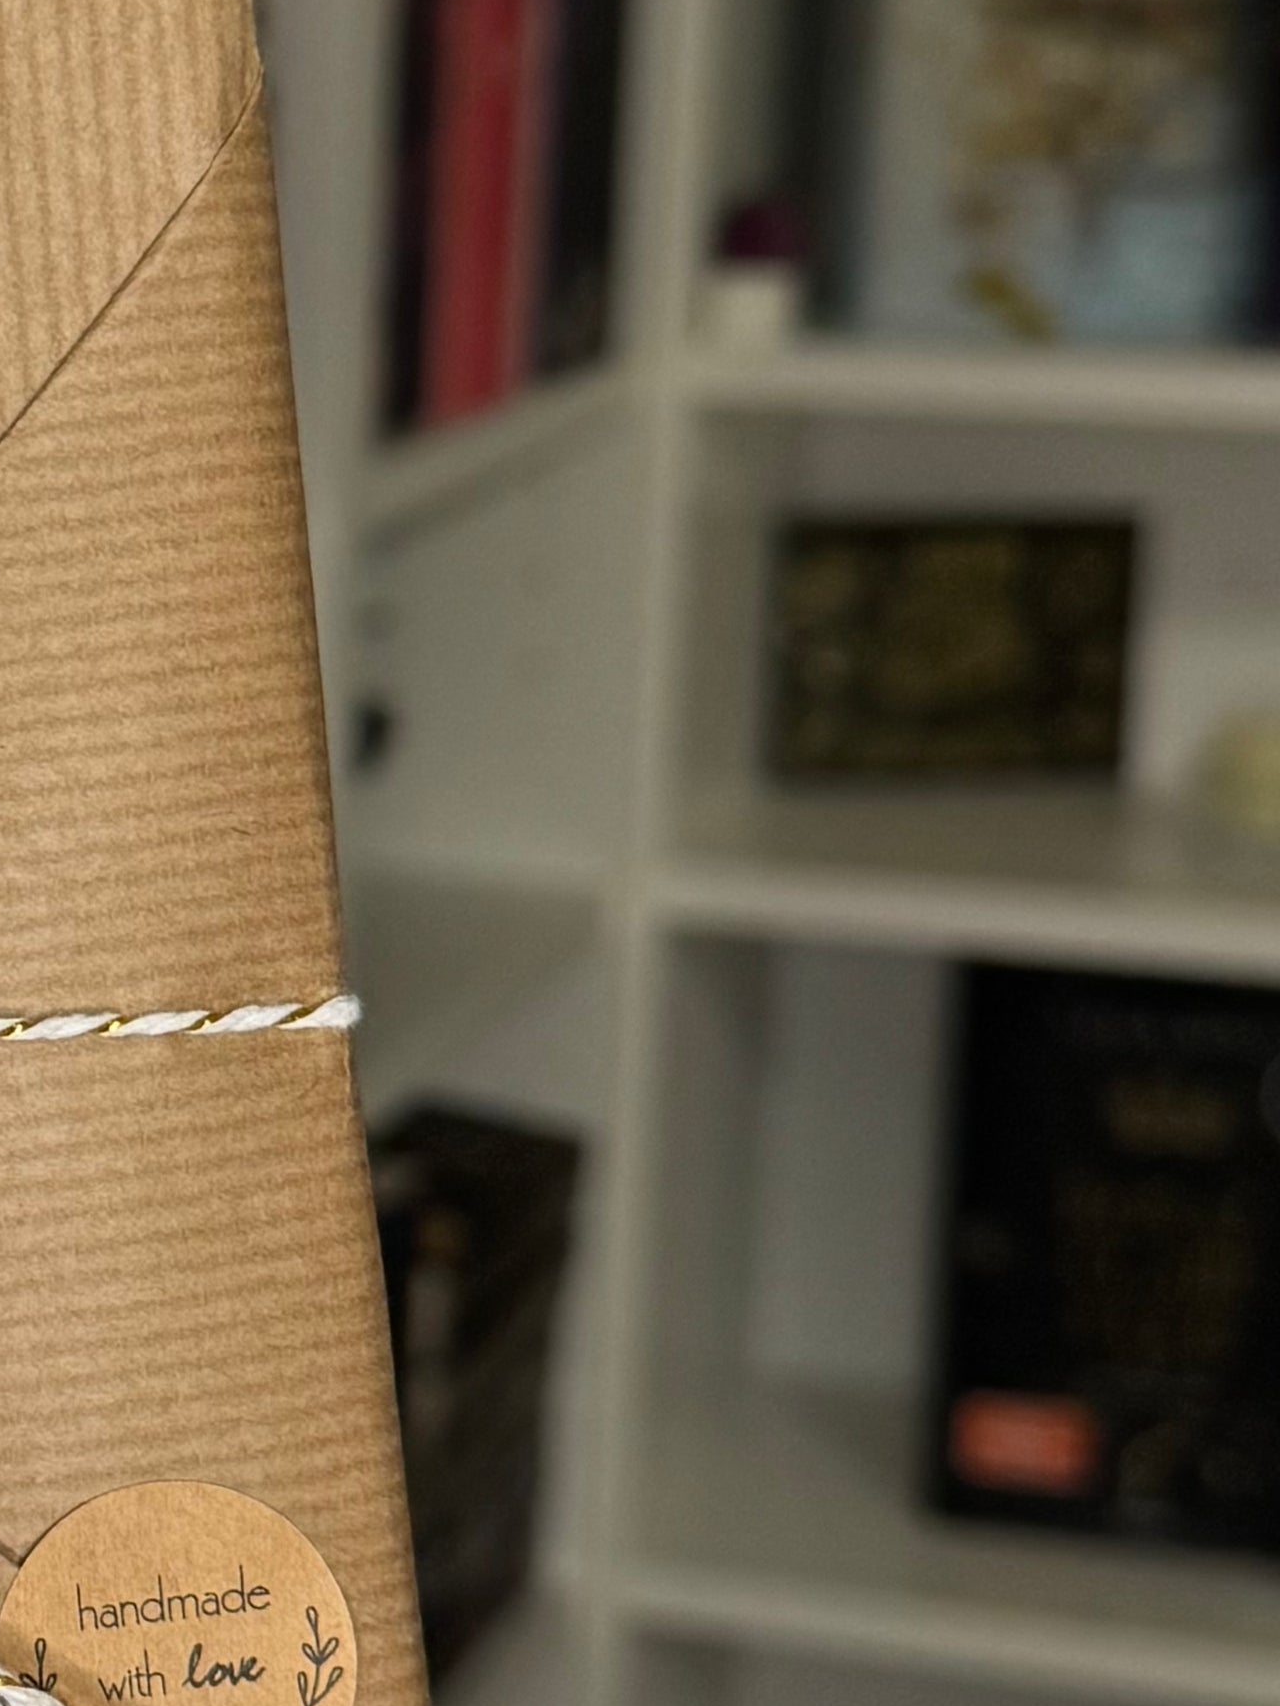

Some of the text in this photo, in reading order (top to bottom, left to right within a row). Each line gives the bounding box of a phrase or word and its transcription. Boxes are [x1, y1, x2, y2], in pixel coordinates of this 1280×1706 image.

[76, 1564, 271, 1631] handmade
[97, 1642, 266, 1702] with love
